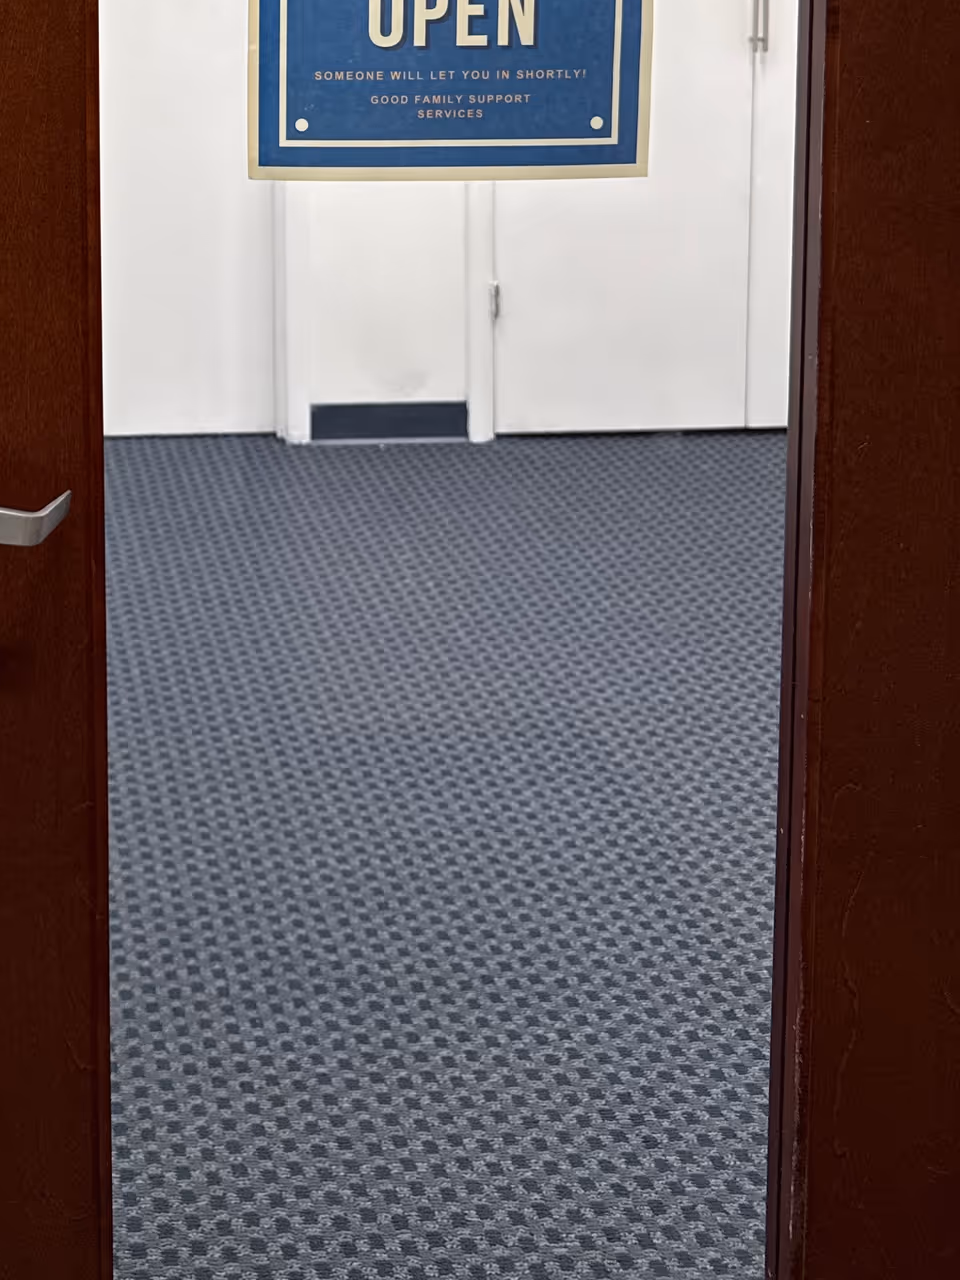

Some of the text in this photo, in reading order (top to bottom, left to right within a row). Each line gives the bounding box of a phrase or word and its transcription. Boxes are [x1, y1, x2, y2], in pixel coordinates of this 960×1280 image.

[314, 69, 586, 80] SOMEONE WILL LET YOU IN SHORTLY!
[371, 94, 531, 104] GOOD FAMILY SUPPORT
[417, 109, 483, 118] SERVICES
